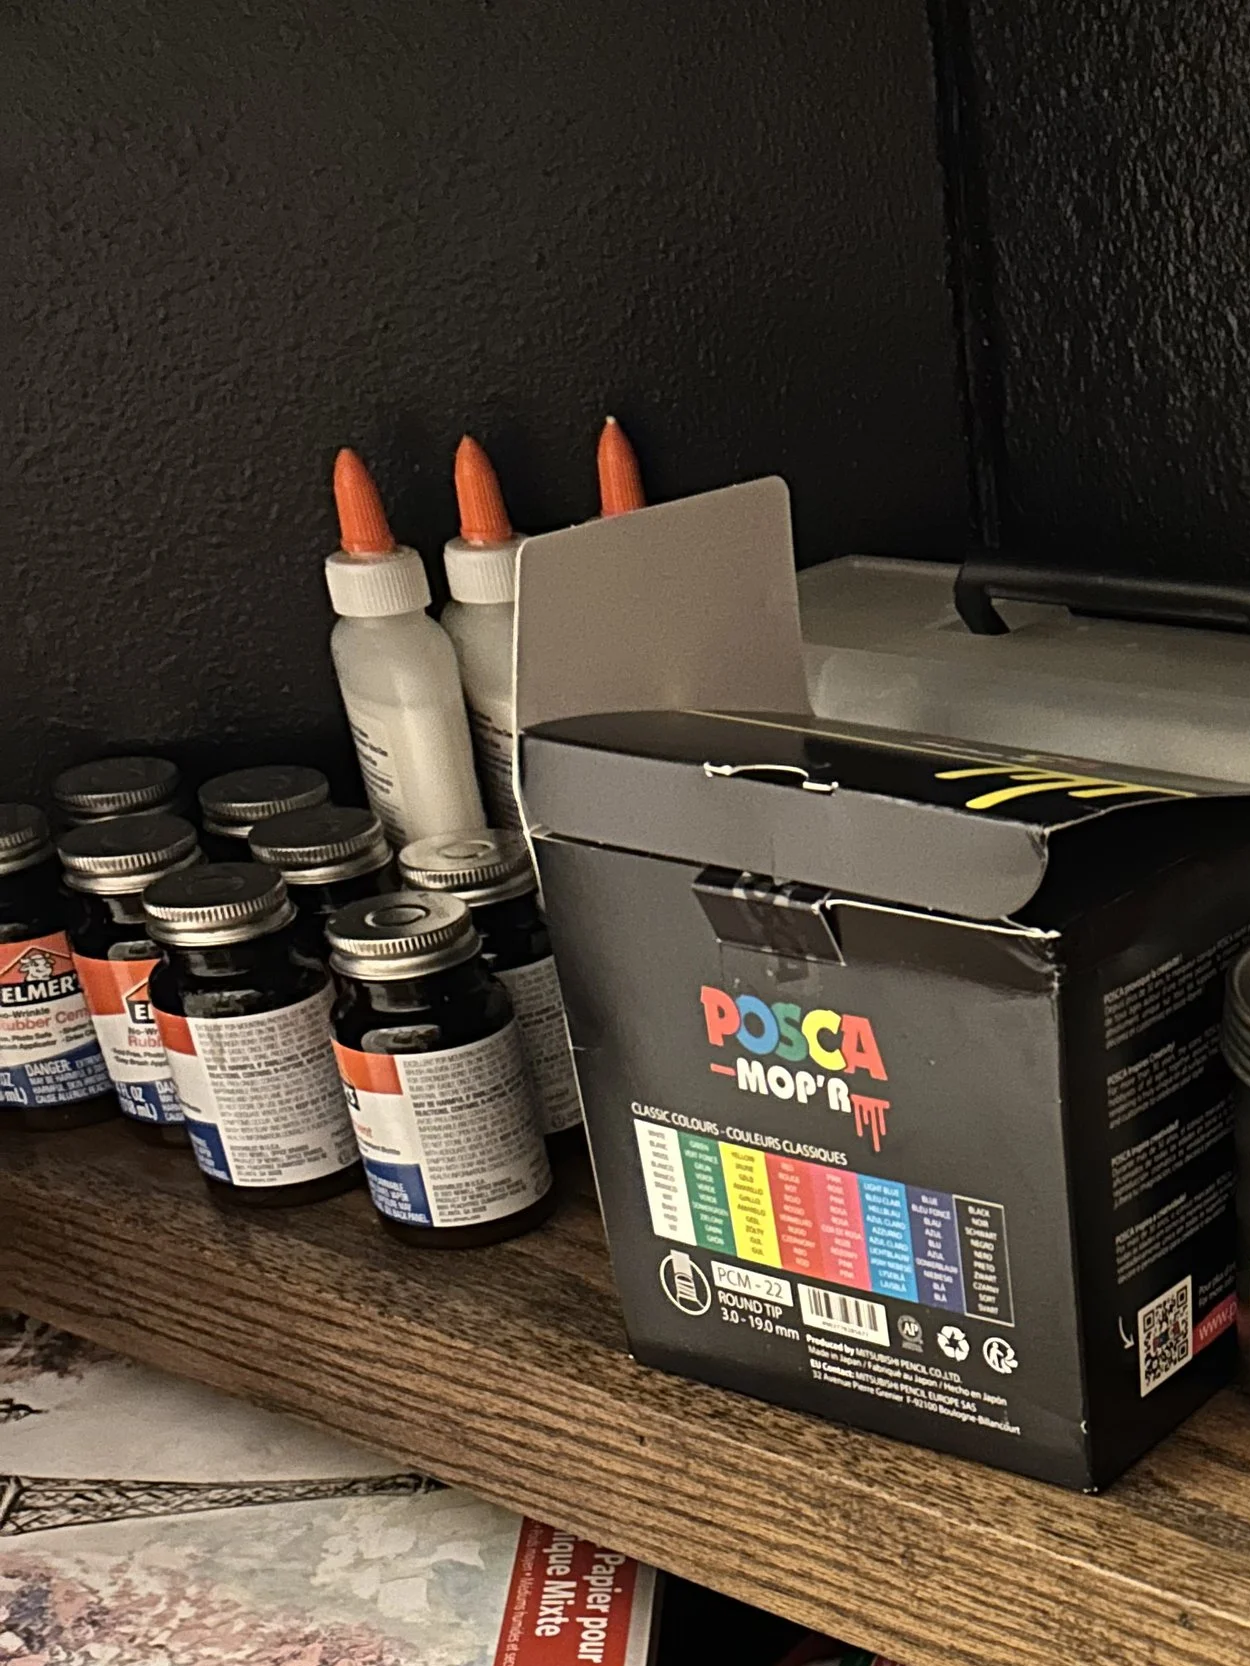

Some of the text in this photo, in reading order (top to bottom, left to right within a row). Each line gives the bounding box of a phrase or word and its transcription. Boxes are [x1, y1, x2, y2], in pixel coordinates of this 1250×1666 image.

[700, 985, 888, 1081] POSCA
[630, 1101, 848, 1166] CLASSIC COLOURS COULEURS CLASSIQUES
[967, 1205, 991, 1218] BLACK
[970, 1238, 995, 1252] NEGRO
[973, 1250, 994, 1262] NERO
[716, 1266, 784, 1300] PCM 22
[717, 1290, 783, 1319] ROUND TIP
[721, 1305, 739, 1325] 3.0
[749, 1314, 774, 1333] 19.0
[775, 1325, 800, 1341] mm
[805, 1333, 844, 1352] Produced
[843, 1343, 855, 1357] by
[855, 1347, 900, 1367] MITSUBISHI
[900, 1358, 929, 1375] PENCIL
[807, 1344, 830, 1359] Made
[830, 1351, 839, 1361] in
[839, 1353, 863, 1367] Japan
[943, 1382, 970, 1397] Hecho
[809, 1358, 822, 1370] EU
[855, 1370, 900, 1391] MITSUBISHI
[900, 1382, 928, 1399] PENCIL
[928, 1390, 960, 1408] EUROPE
[960, 1399, 978, 1413] SAS
[823, 1373, 853, 1388] Avenue
[852, 1379, 875, 1395] Pierre
[875, 1387, 904, 1403] Grenier
[534, 1580, 578, 1637] Mixte
[575, 1553, 626, 1664] Papier pour
[508, 1611, 528, 1642] humides
[505, 1643, 519, 1652] et
